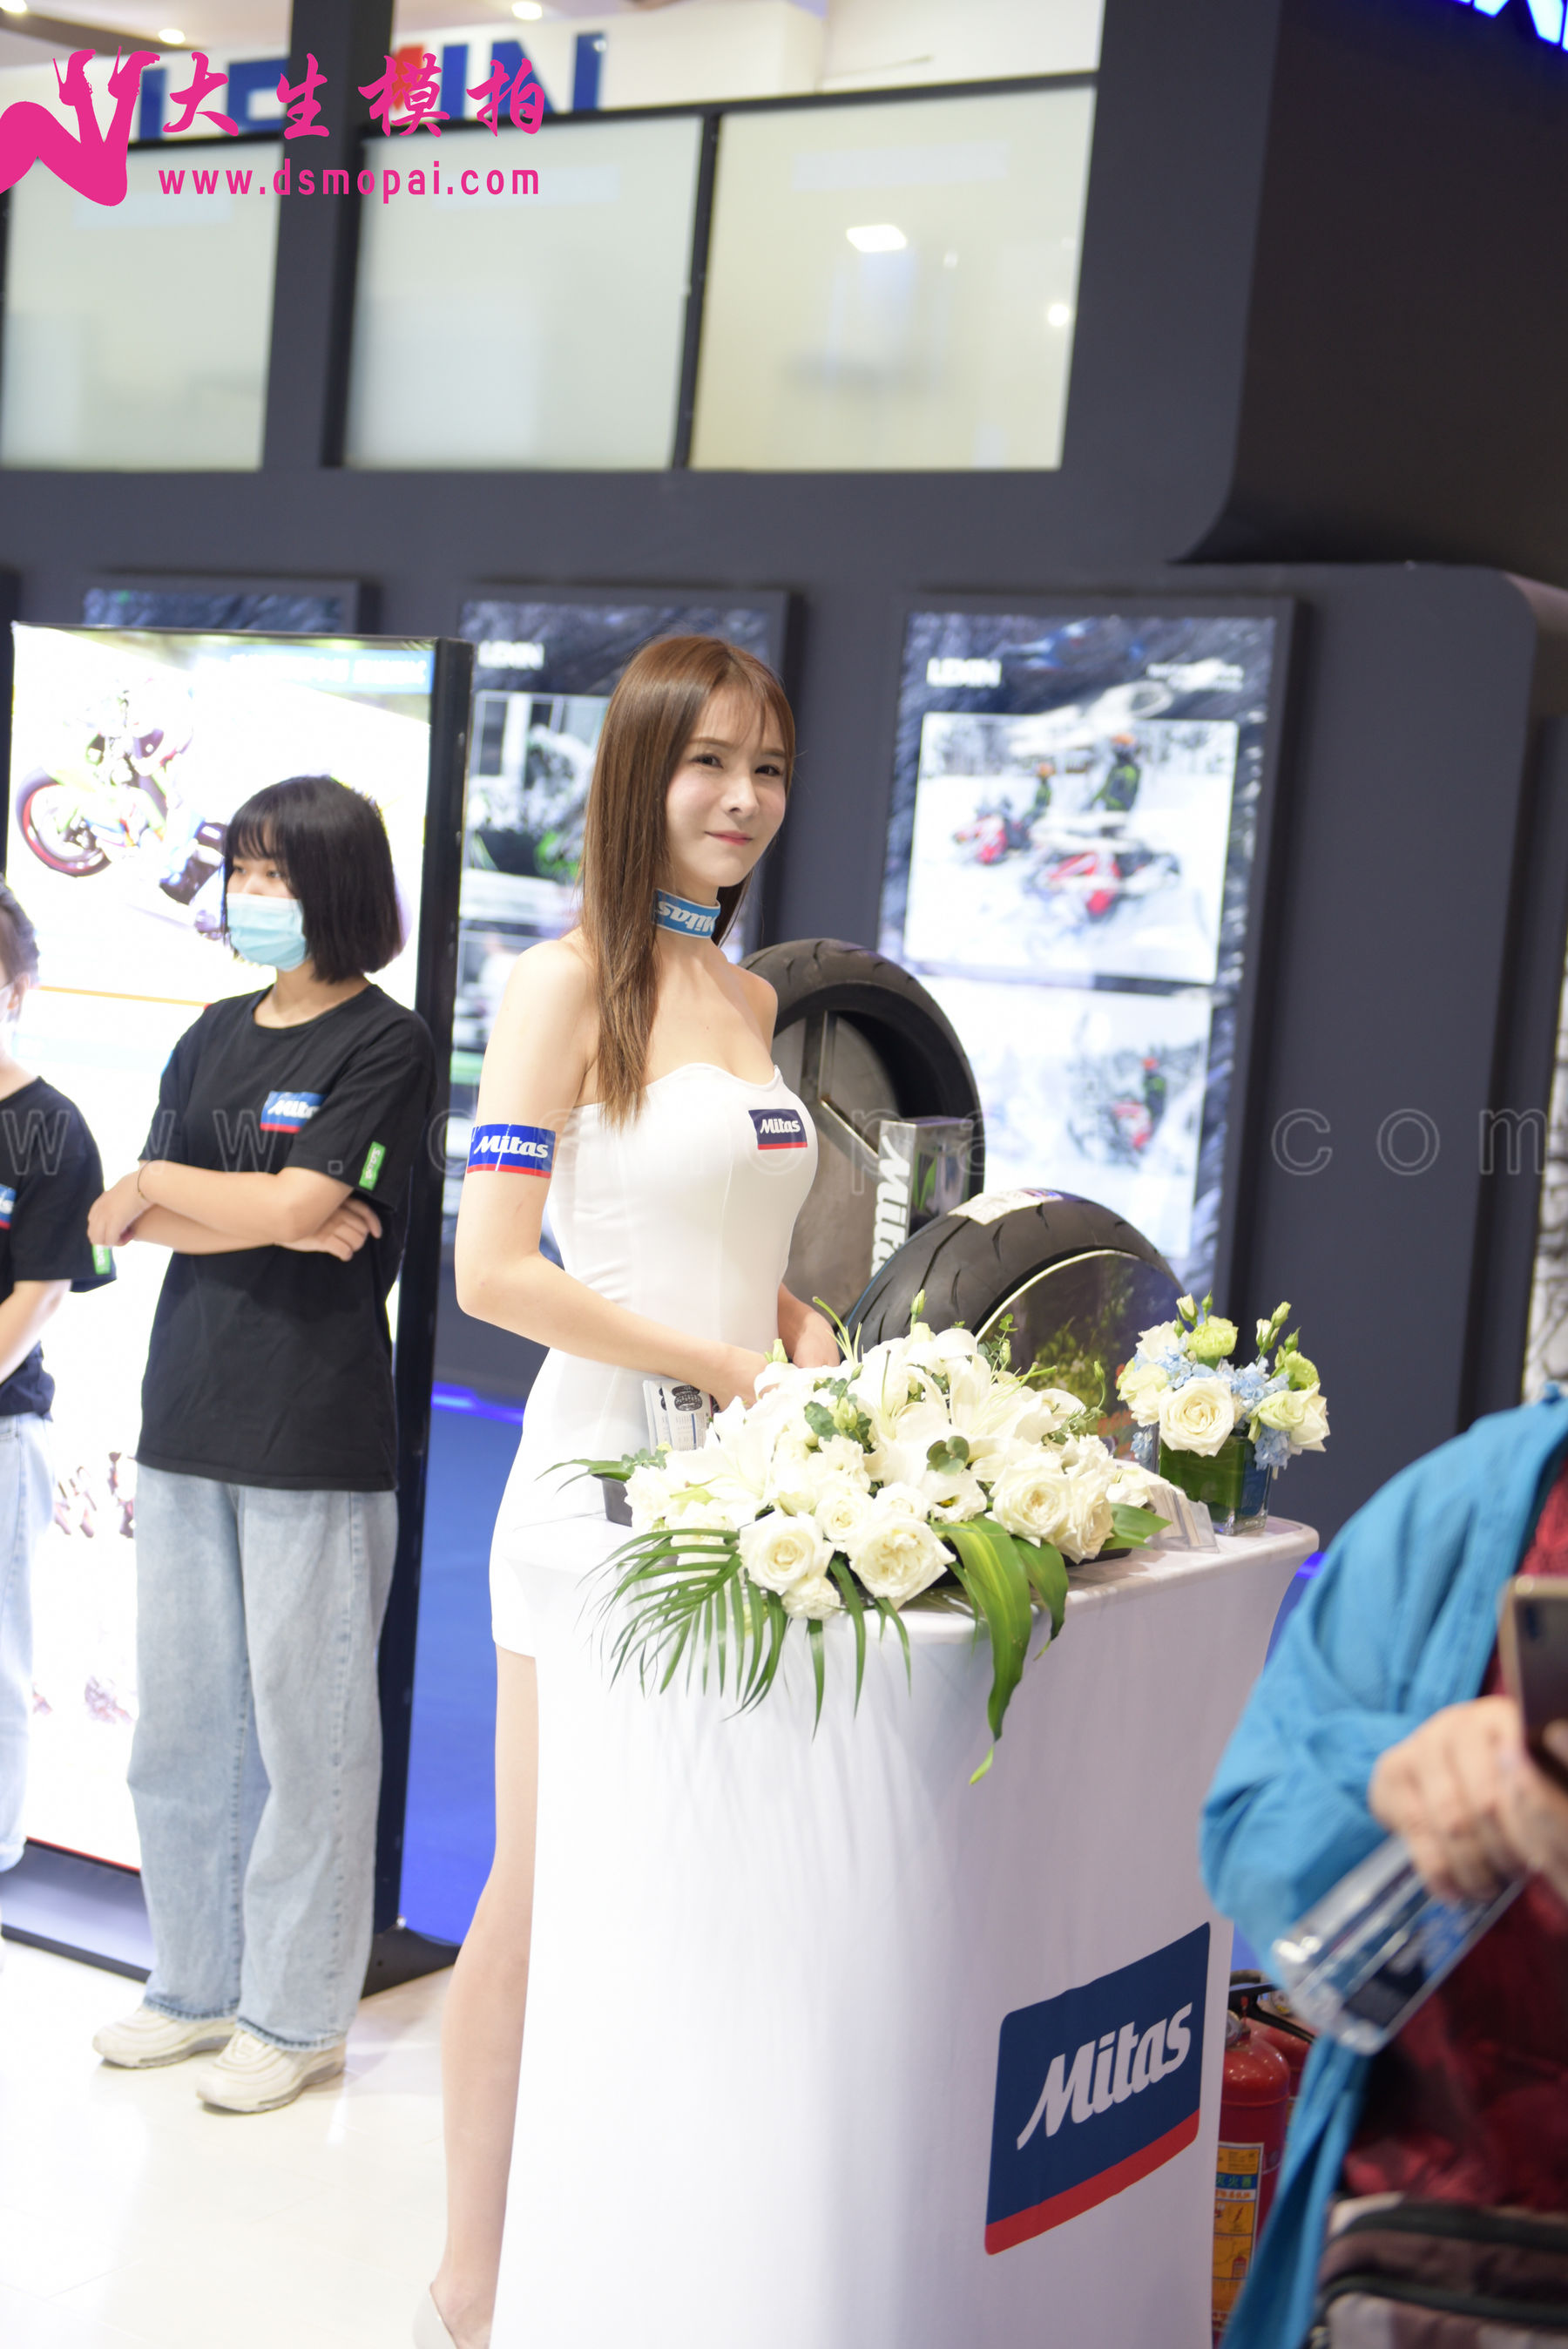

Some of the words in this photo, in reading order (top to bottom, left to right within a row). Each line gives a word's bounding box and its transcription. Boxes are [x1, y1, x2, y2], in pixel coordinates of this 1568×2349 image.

[473, 1135, 549, 1159] Mitas
[760, 1118, 801, 1134] Mitas
[871, 1135, 910, 1278] Mita
[1017, 2002, 1193, 2150] Mitas
